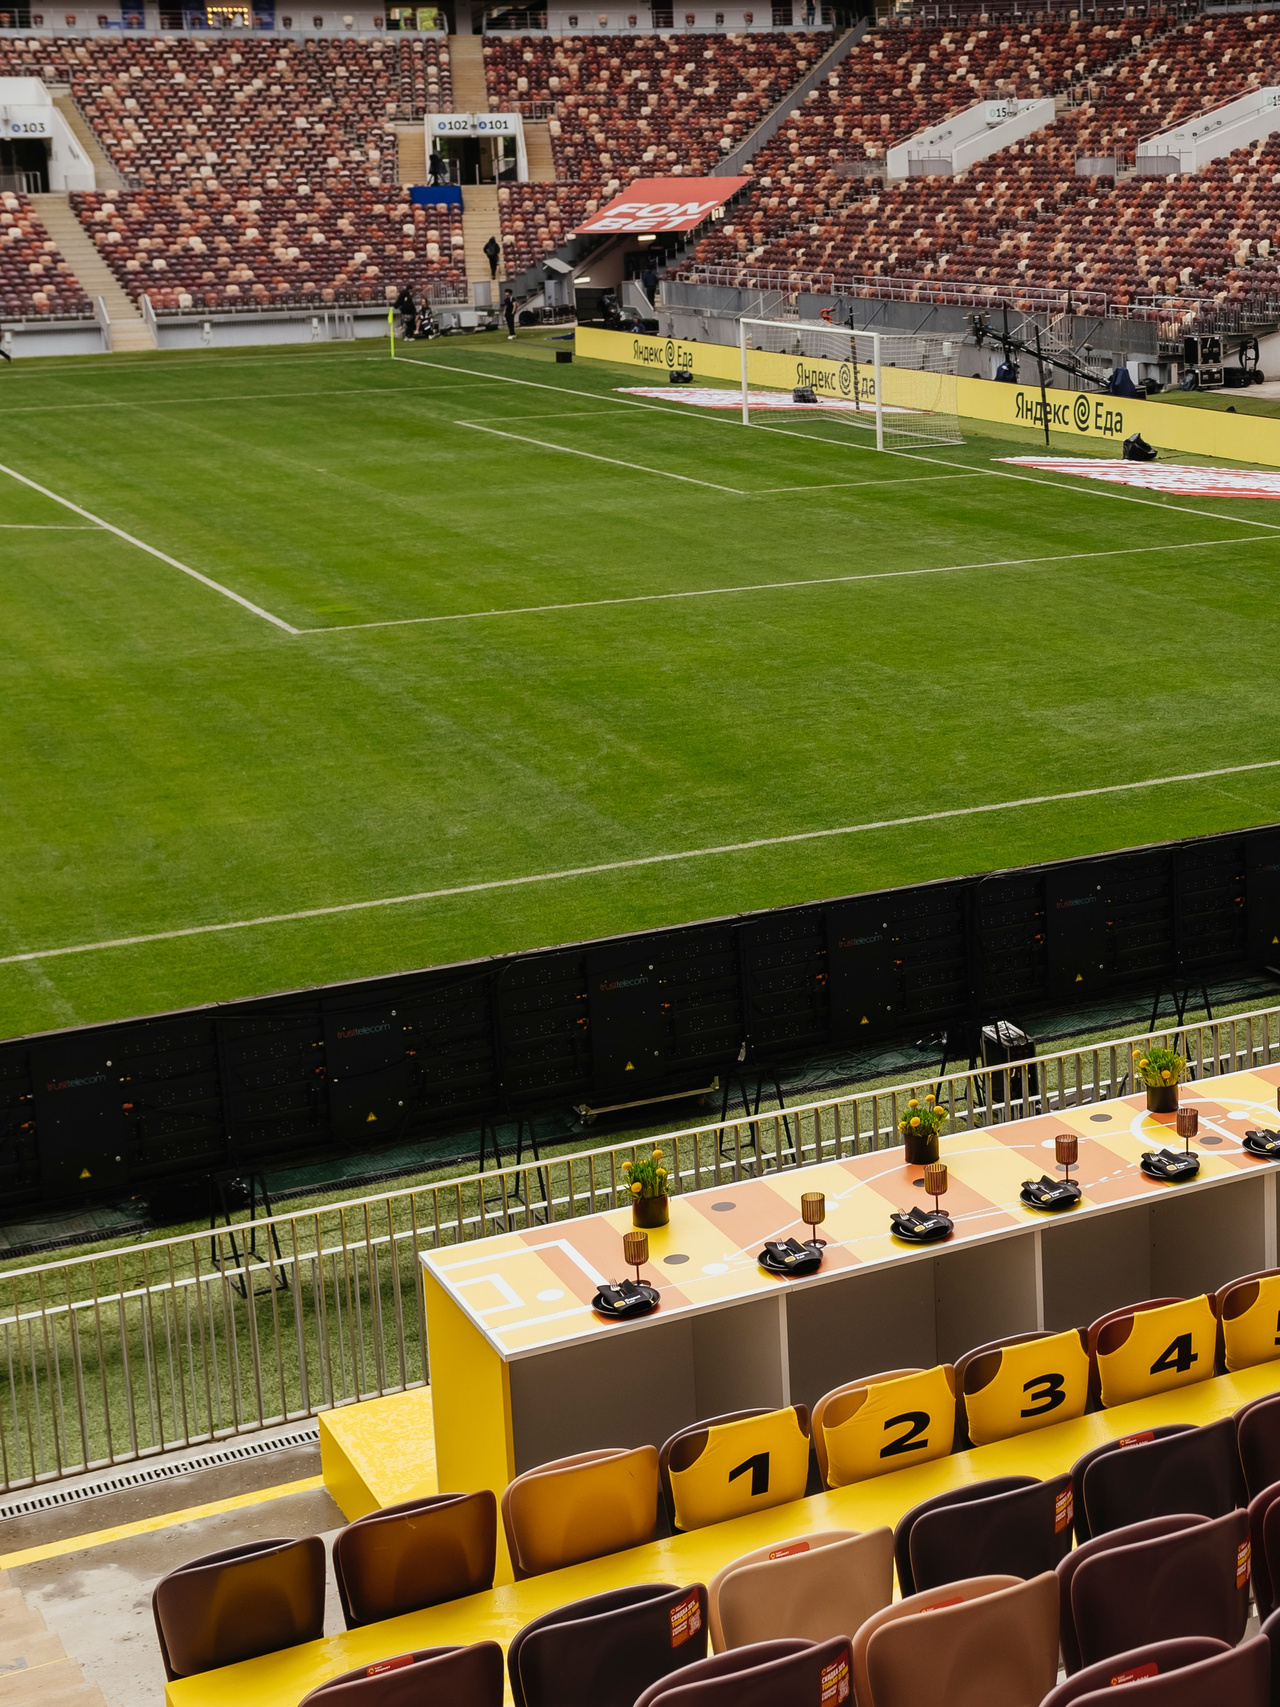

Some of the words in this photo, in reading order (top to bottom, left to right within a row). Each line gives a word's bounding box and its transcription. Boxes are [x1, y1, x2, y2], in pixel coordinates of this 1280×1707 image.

[23, 122, 45, 133] 103
[448, 120, 468, 130] 102
[489, 119, 509, 130] 101
[583, 213, 702, 231] BET
[602, 200, 719, 217] FON
[633, 338, 663, 364] Яндекс
[677, 345, 693, 369] Еда
[796, 362, 836, 391] Яндекс
[1015, 392, 1070, 426] Яндекс
[1094, 401, 1123, 437] Еда
[1150, 1332, 1199, 1376] 4
[1020, 1373, 1067, 1419] 3
[879, 1411, 931, 1460] 2
[728, 1451, 770, 1498] 1
